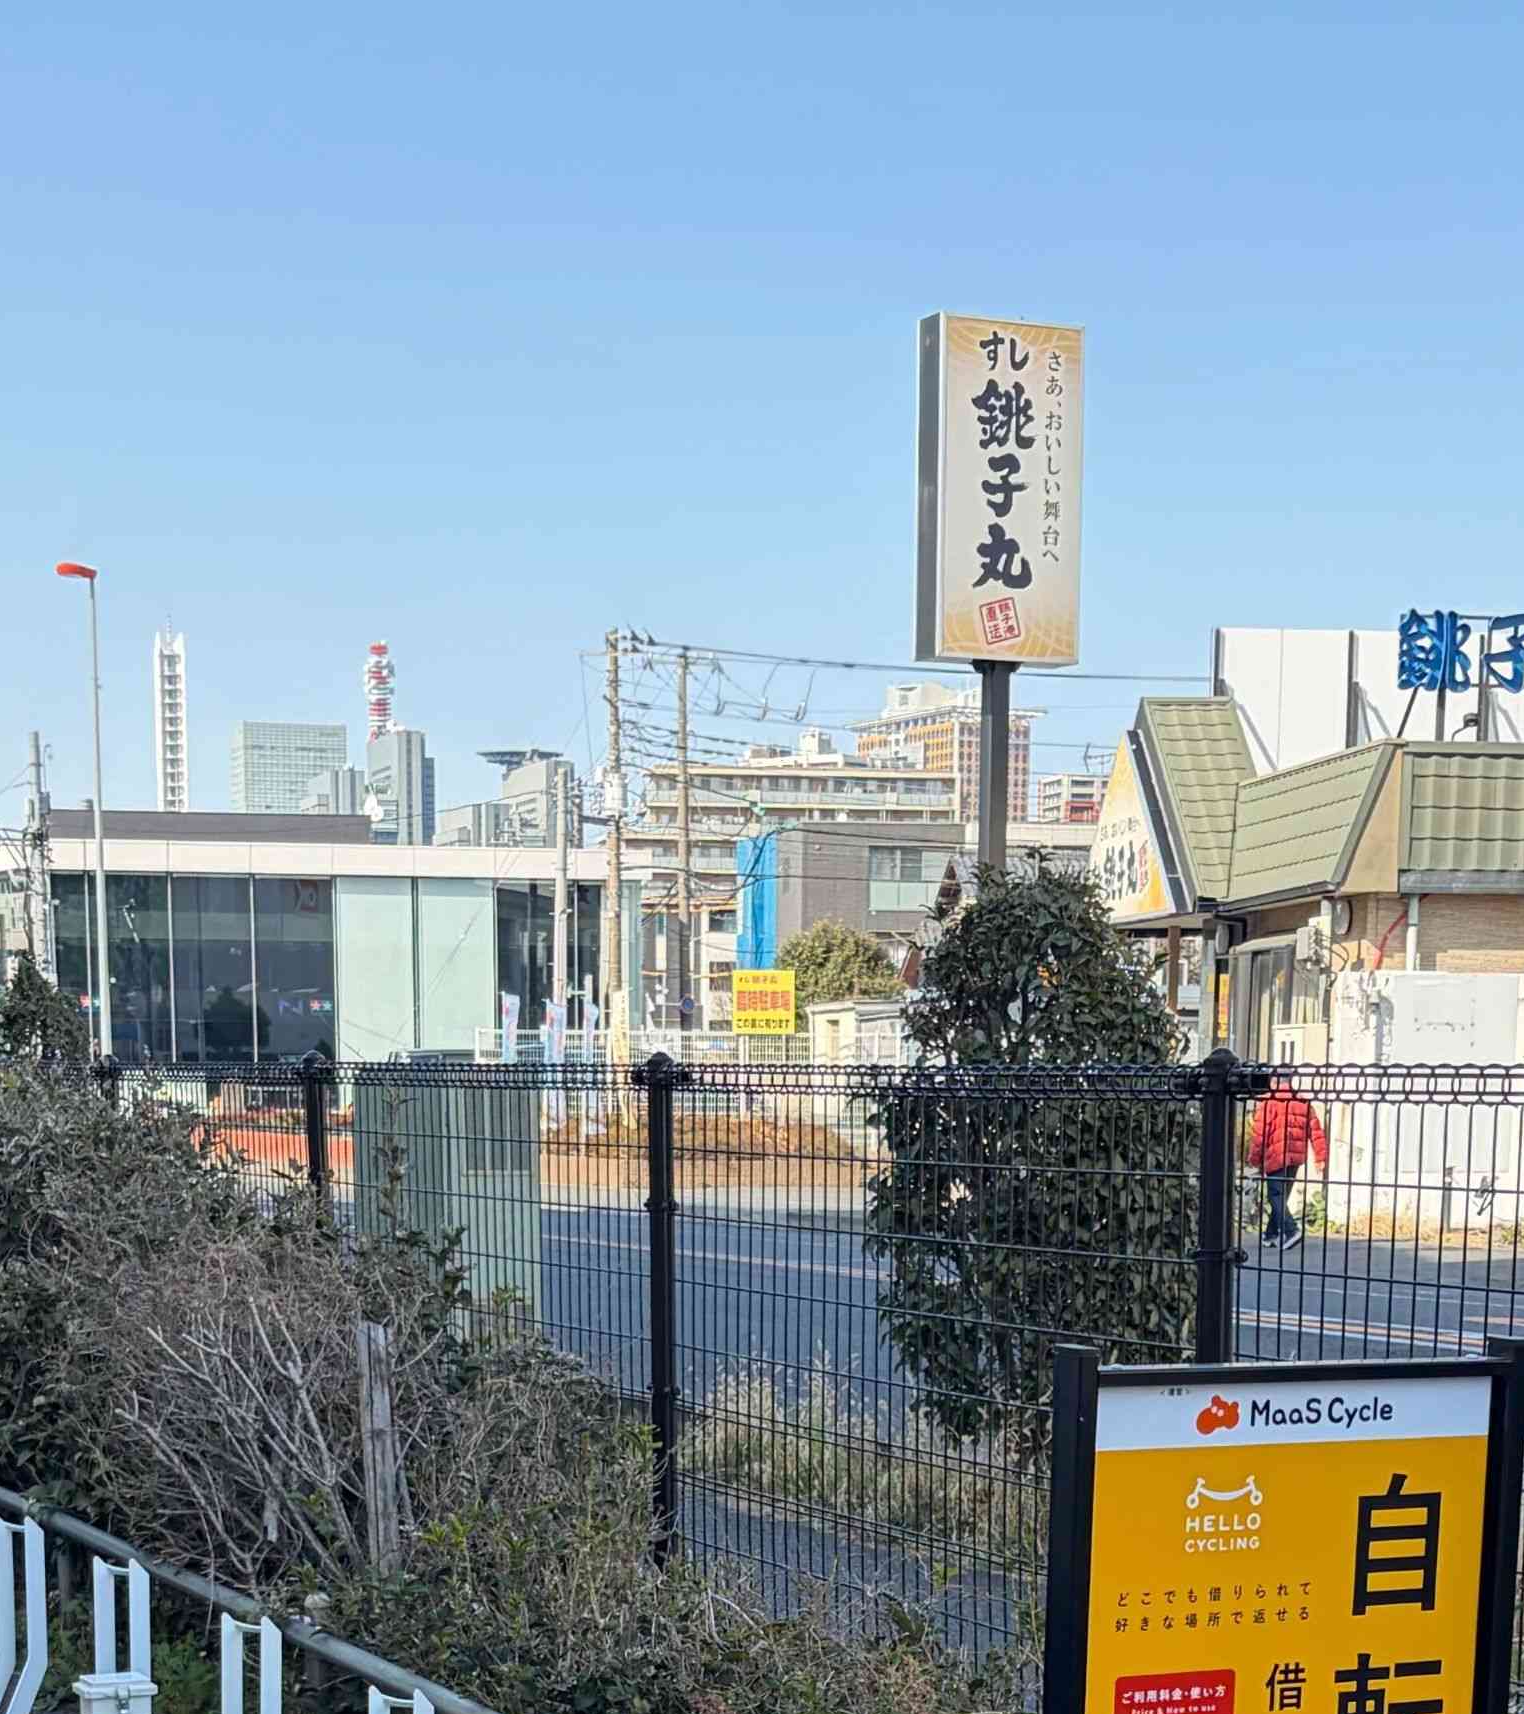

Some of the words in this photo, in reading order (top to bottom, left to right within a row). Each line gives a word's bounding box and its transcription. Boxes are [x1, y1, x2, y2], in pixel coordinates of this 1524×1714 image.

[980, 331, 1029, 372] すし
[1041, 351, 1064, 564] さあ、おいしい舞台へ
[971, 378, 1036, 590] 銚子丸
[1250, 1398, 1322, 1427] MaaS
[1327, 1396, 1393, 1429] Cycle
[1185, 1512, 1262, 1533] HELLO
[1184, 1536, 1261, 1553] CYCLING
[1117, 1581, 1312, 1608] どこでも借りられて
[1114, 1605, 1310, 1633] 好きな場所で返せる
[1188, 1705, 1198, 1713] to
